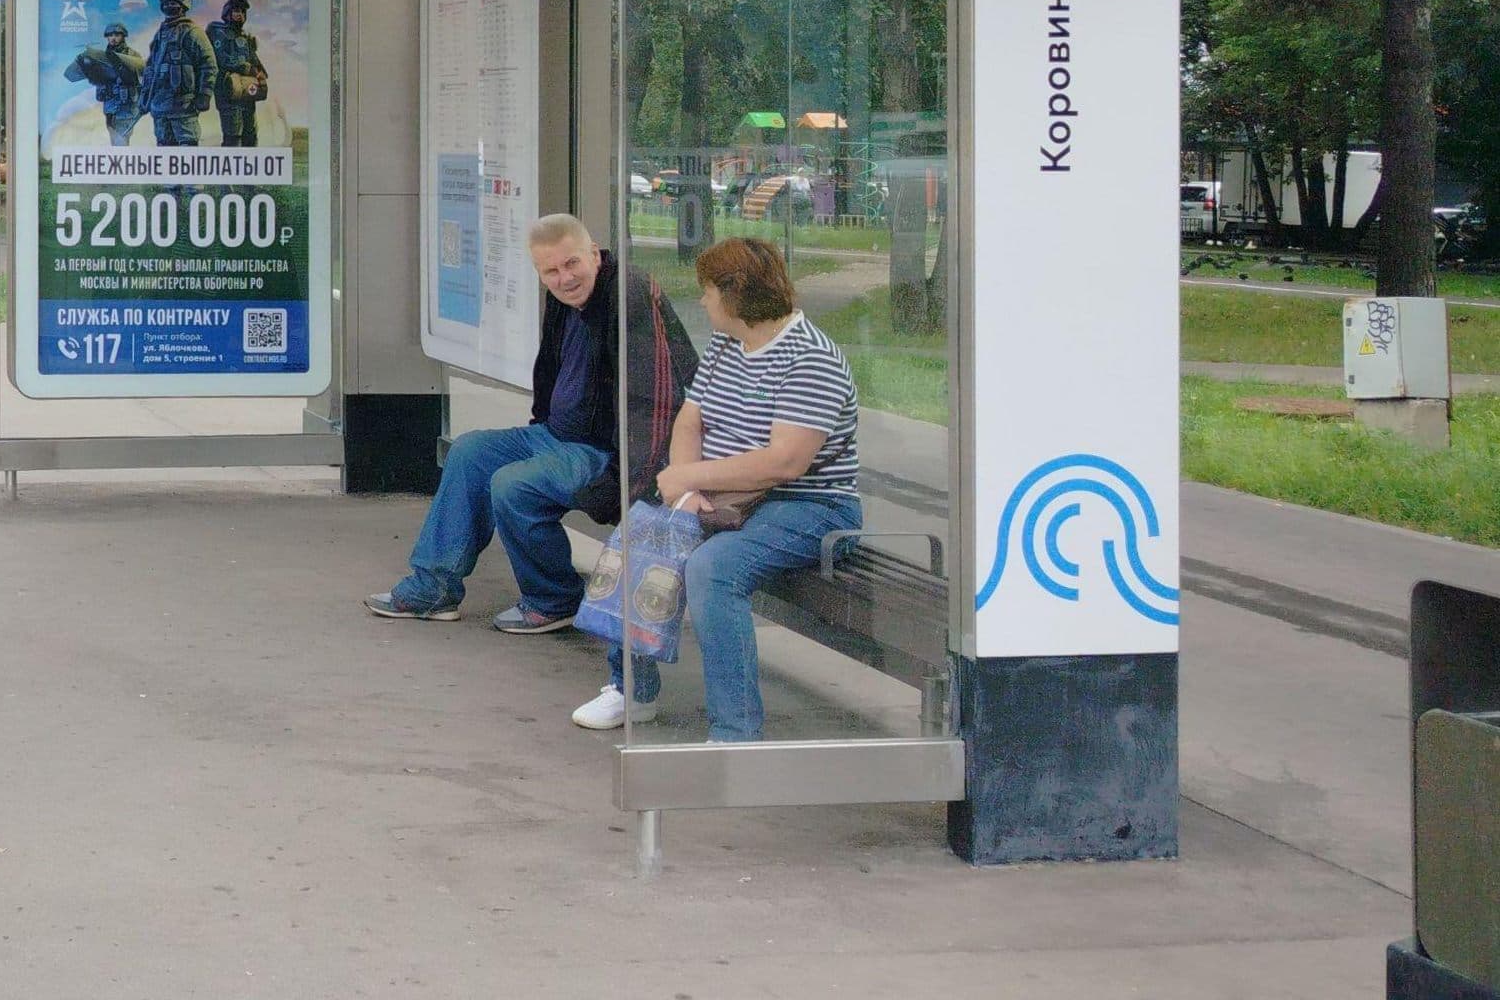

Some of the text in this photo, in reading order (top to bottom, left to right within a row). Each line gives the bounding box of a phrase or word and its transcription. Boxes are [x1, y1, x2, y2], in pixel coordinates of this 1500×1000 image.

[60, 154, 285, 177] ДЕНЕЖНЫЕ ВЫПЛАТЫ ОТ
[56, 192, 82, 247] 5
[90, 192, 177, 247] 200
[54, 257, 289, 273] ЗА ПЕРВЫЙ ГОД С УЧЕТОМ ВЫПЛАТ ПРАВИТЕЛЬСТВА
[80, 276, 264, 290] МОСКВЫ И МИНИСТЕРСТВА ОБОРОНЫ РФ
[57, 308, 231, 326] СЛУЖБА ПО КОНТРАКТУ
[143, 332, 203, 342] Пункт отбора:
[83, 333, 122, 364] 117
[143, 344, 211, 353] ул. Яблочкова,
[143, 355, 162, 364] дом
[174, 355, 217, 364] строение
